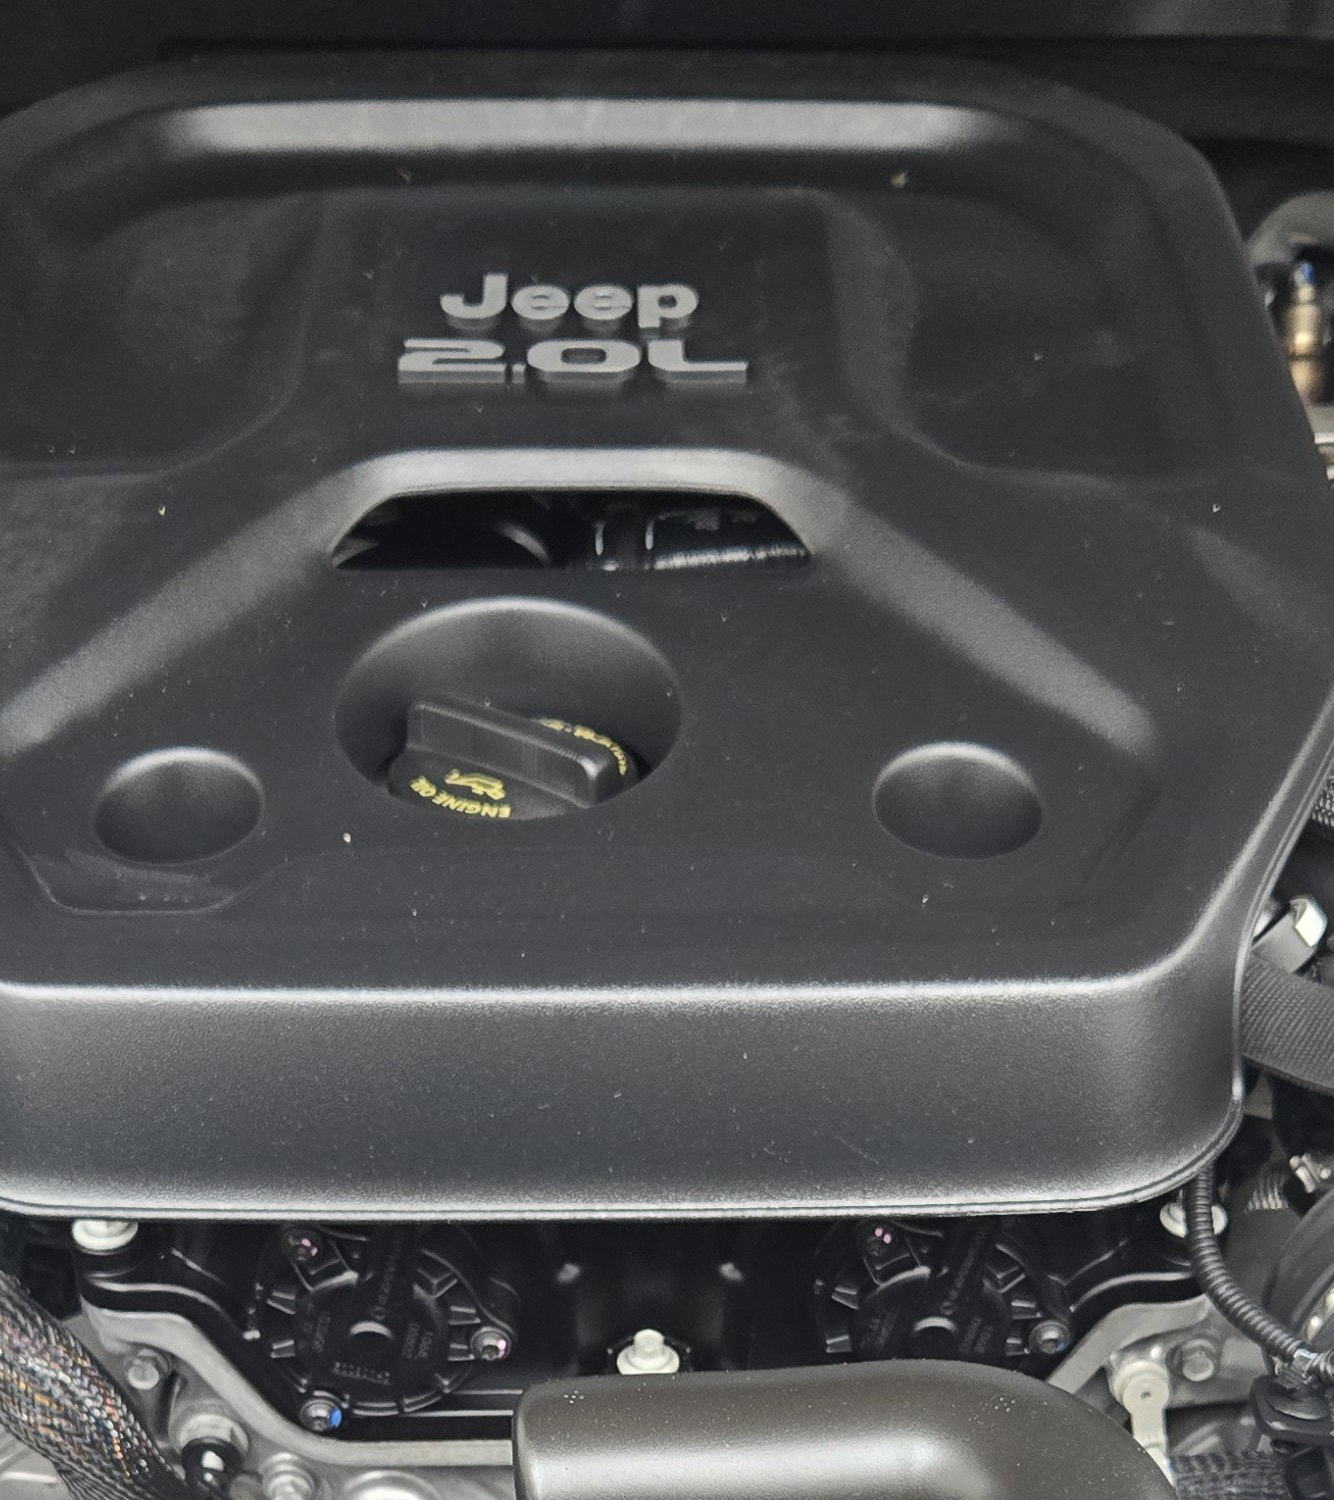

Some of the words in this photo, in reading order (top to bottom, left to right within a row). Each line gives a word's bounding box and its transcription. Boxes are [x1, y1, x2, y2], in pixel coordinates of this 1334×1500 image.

[440, 272, 699, 329] Jeep
[398, 338, 748, 384] 2.0L
[409, 775, 437, 798] OIL
[432, 792, 511, 819] ENGINE
